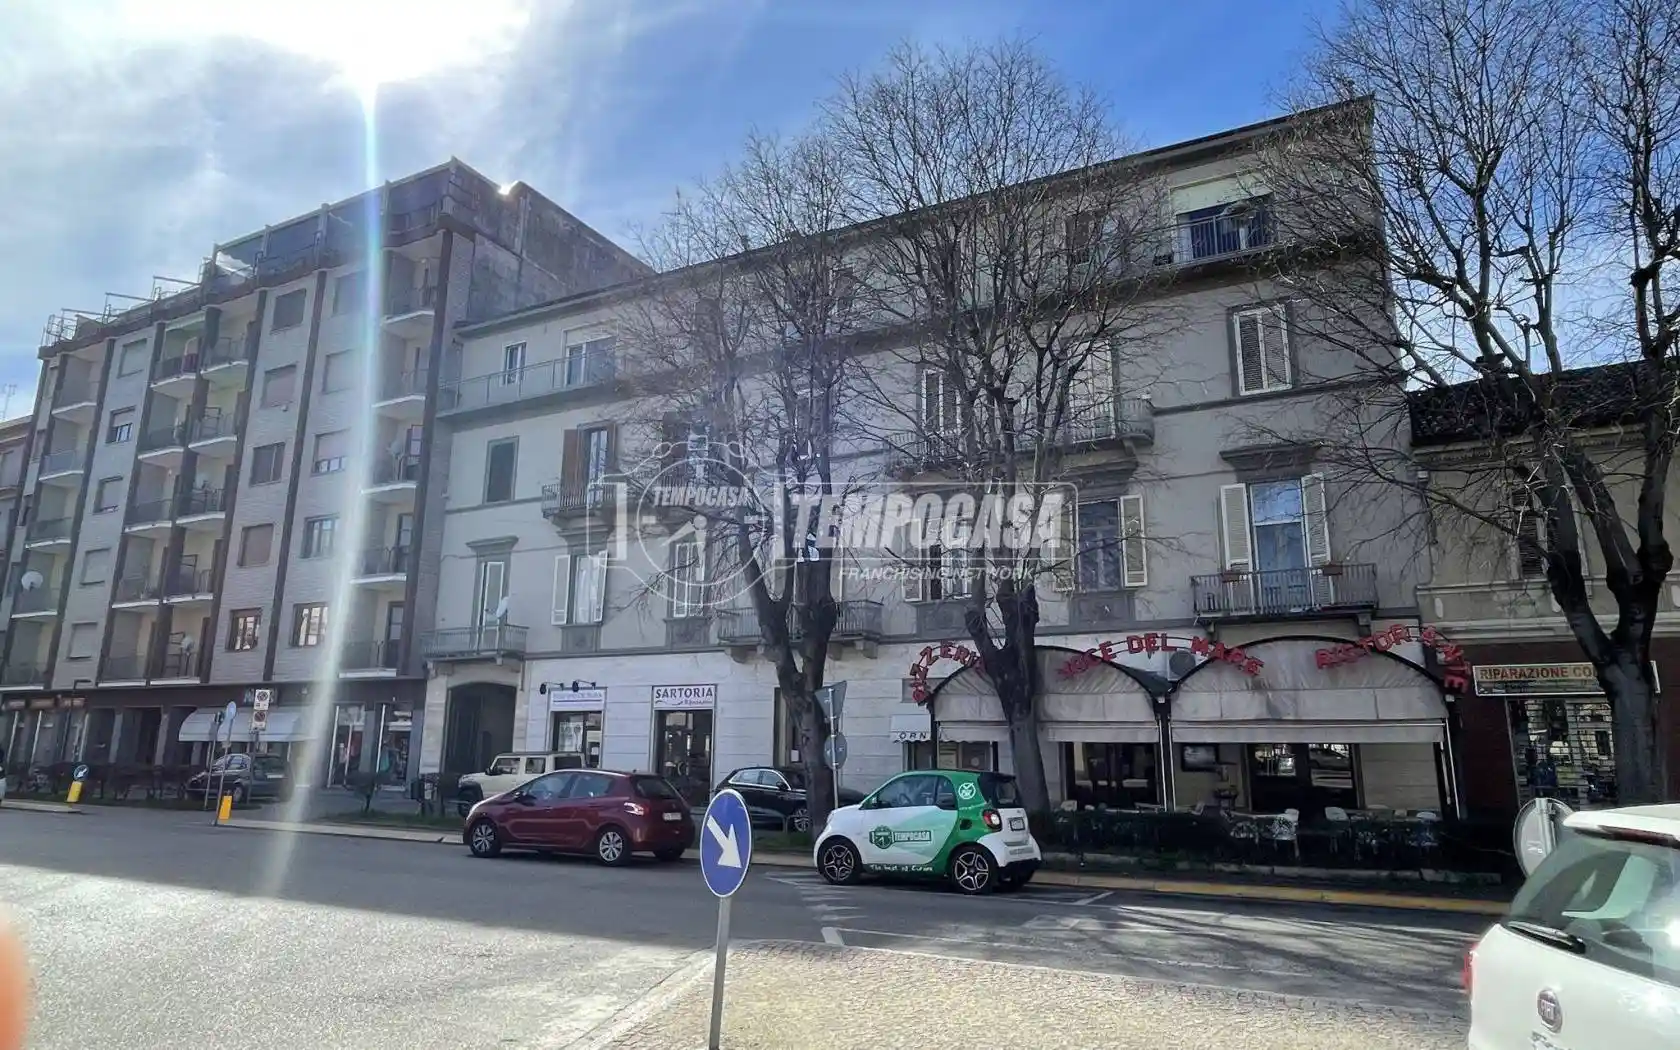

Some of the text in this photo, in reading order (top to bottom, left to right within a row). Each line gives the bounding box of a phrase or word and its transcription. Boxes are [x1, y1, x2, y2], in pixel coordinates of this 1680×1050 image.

[1126, 632, 1177, 655] DEL
[1479, 666, 1569, 681] RIPARAZIONE
[655, 686, 714, 700] SARTORIA
